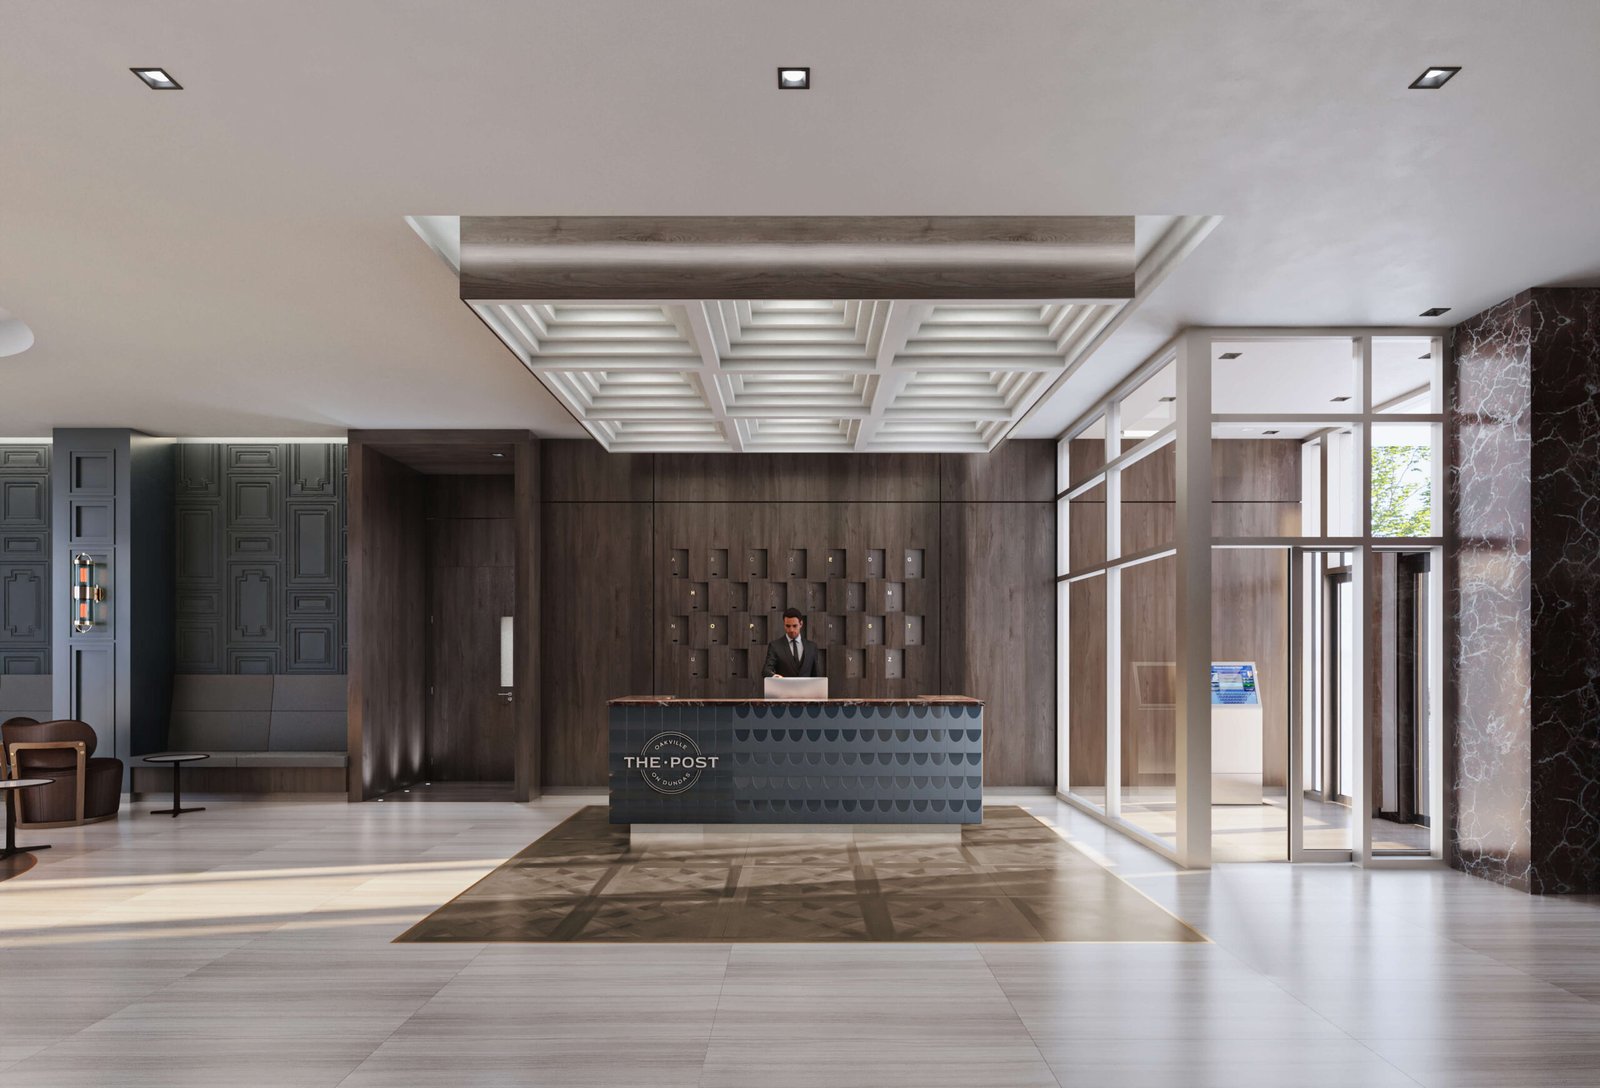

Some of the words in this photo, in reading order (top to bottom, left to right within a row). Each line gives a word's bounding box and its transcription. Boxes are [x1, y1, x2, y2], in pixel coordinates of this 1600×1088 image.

[655, 739, 688, 750] OAKVILLE
[623, 756, 661, 769] THE
[670, 756, 719, 769] POST
[651, 772, 661, 782] ON
[662, 772, 691, 786] DUNDAS
